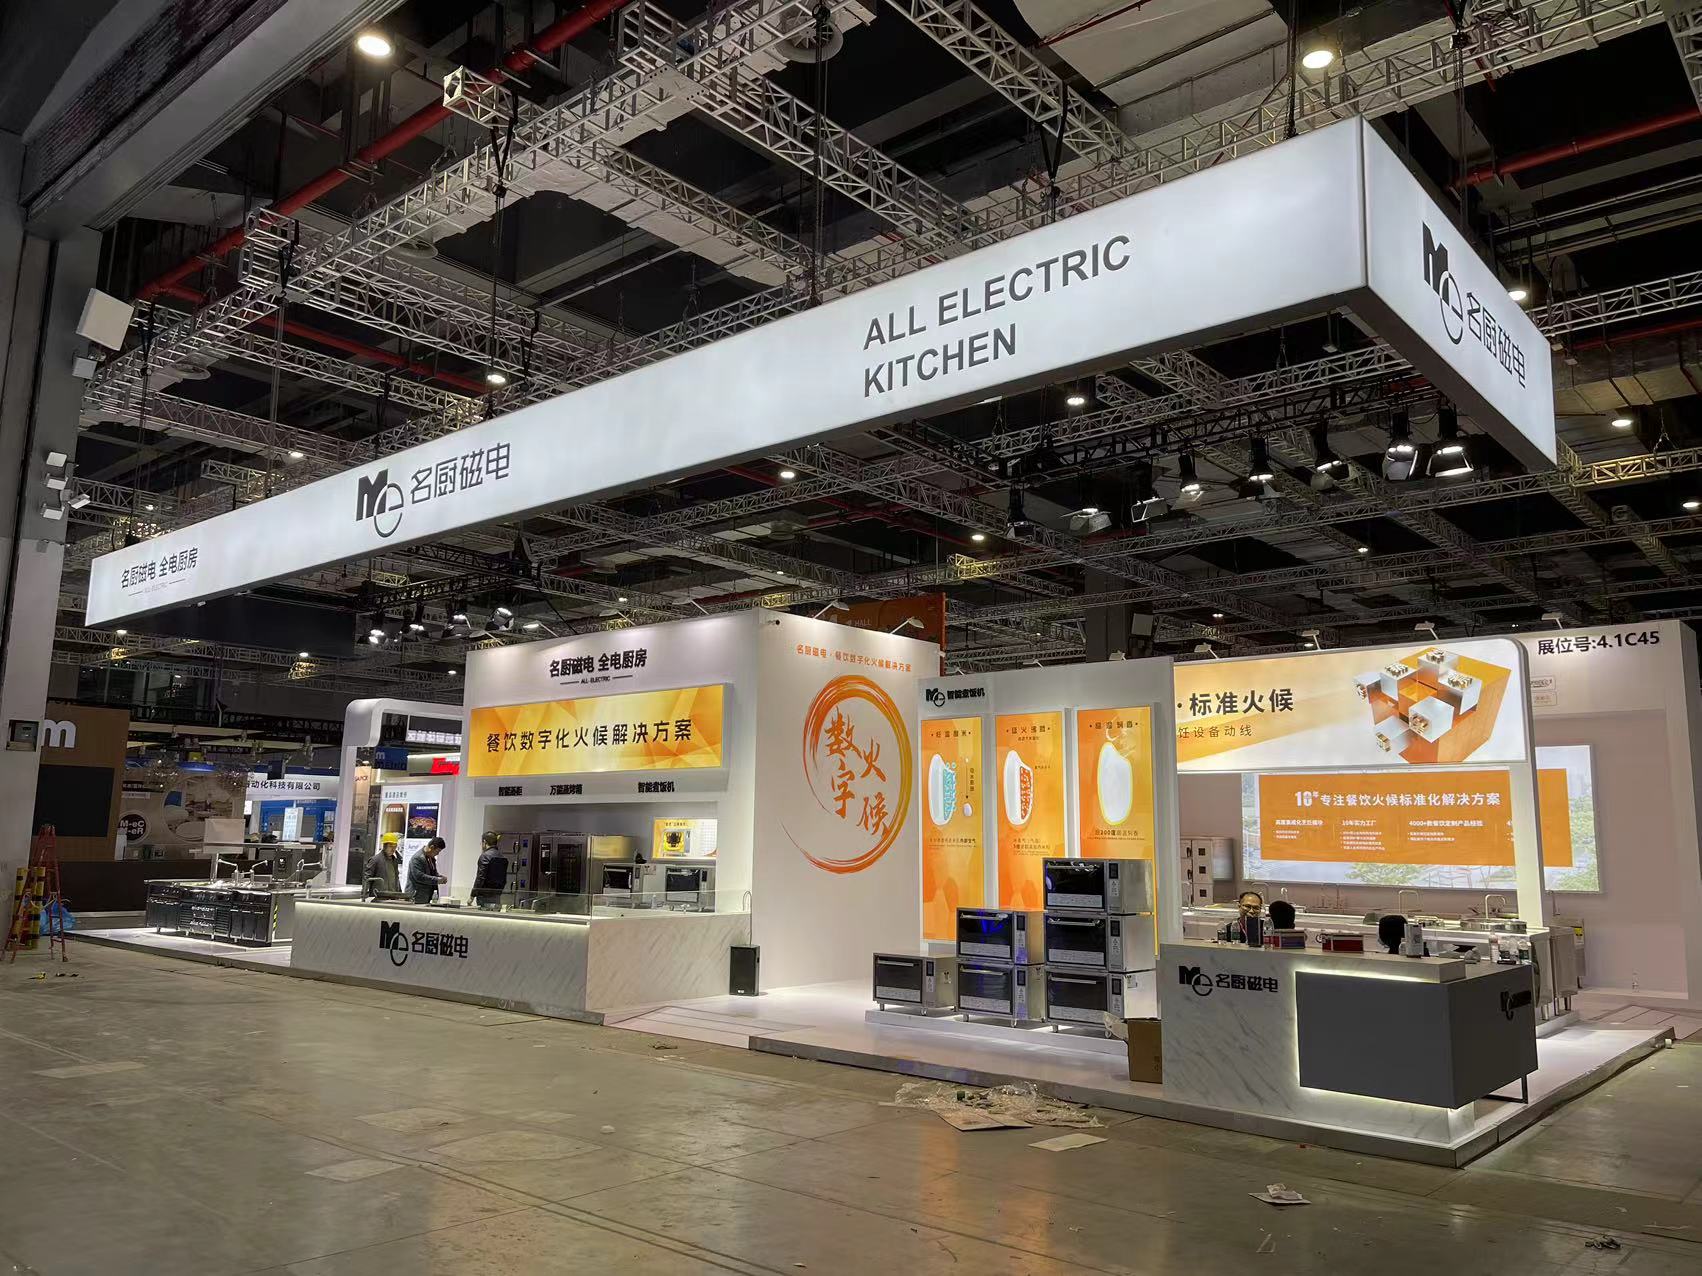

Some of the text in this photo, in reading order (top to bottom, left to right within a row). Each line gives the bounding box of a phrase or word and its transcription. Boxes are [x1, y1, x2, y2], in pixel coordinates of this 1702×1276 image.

[863, 235, 1131, 351] ALL ELECTRIC
[1467, 292, 1526, 389] 名厨磁电
[864, 323, 1016, 398] KITCHEN
[409, 442, 511, 504] 名厨磁电
[121, 547, 198, 589] 名厨磁电 全电厨房
[1538, 631, 1660, 655] 展位号:4.1C45
[549, 648, 648, 678] 名厨磁电 全电厨房
[1189, 688, 1294, 716] 标准火候
[486, 719, 692, 753] 餐饮数字化火候解决方案
[1178, 724, 1252, 739] 饪设备动线
[411, 931, 469, 959] 名厨磁电
[1215, 973, 1279, 993] 名厨磁电
